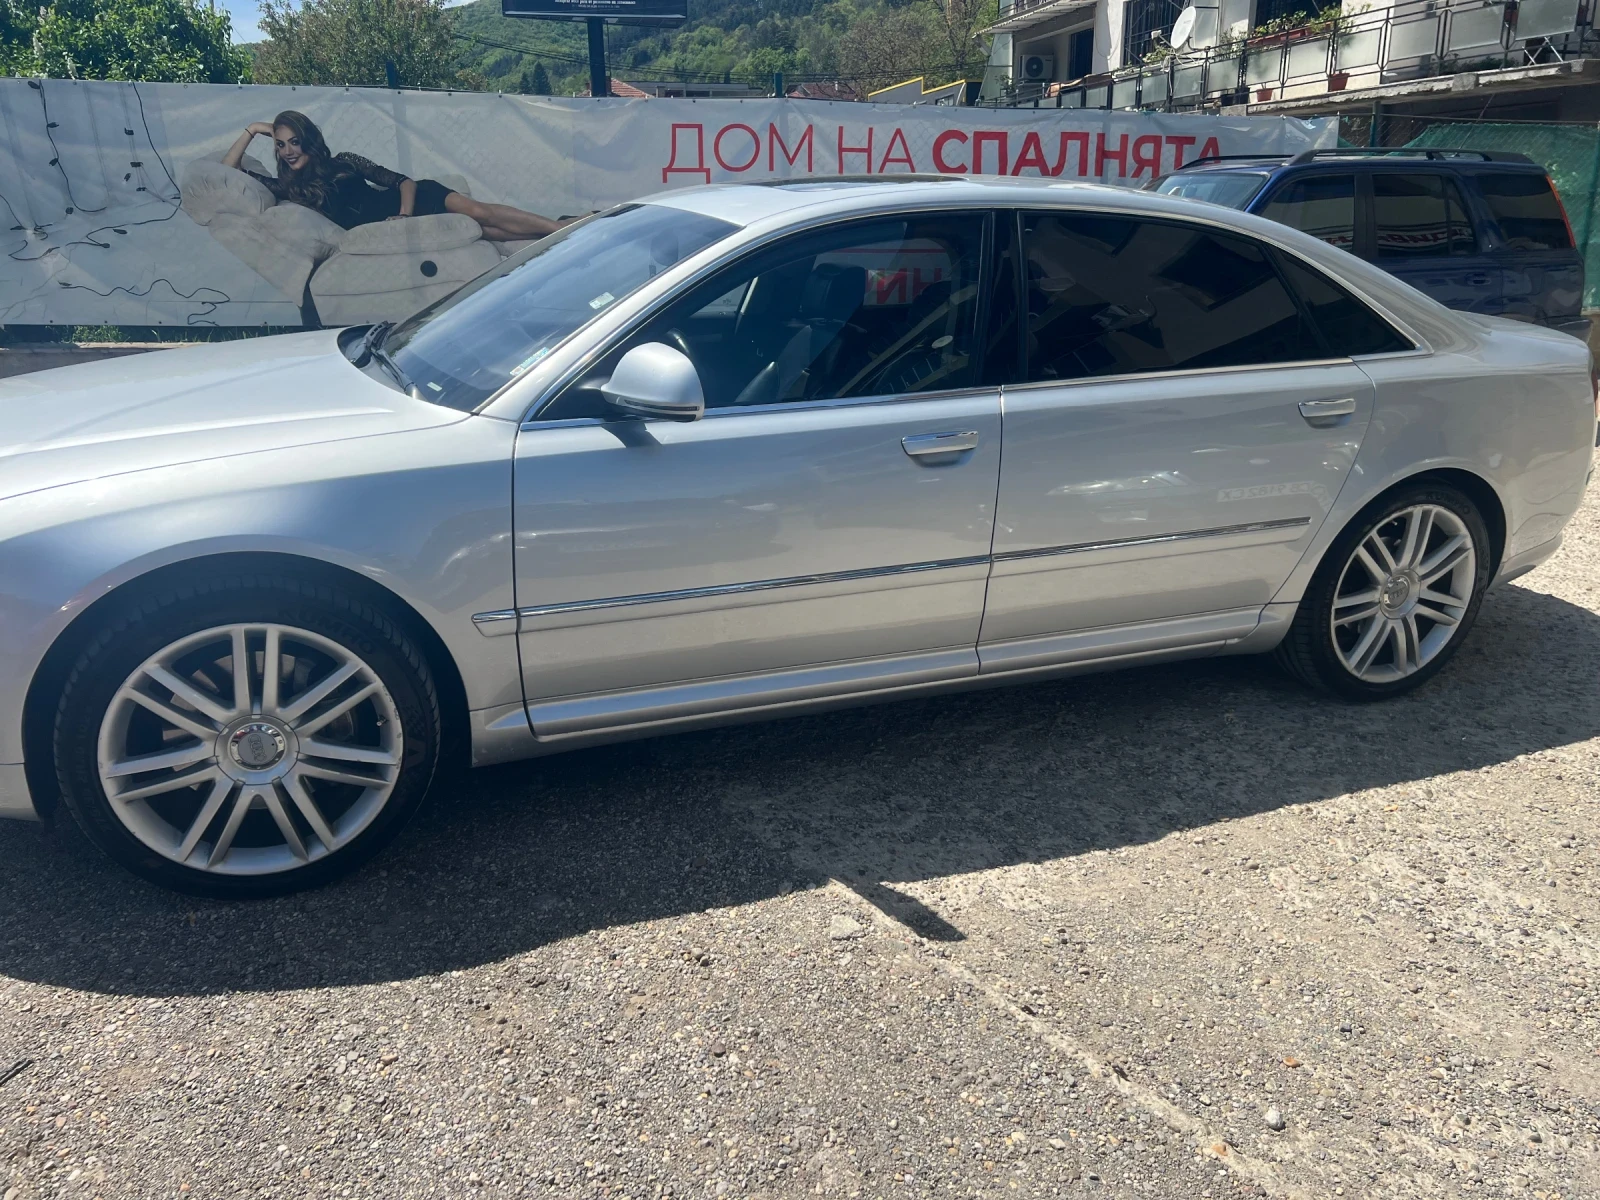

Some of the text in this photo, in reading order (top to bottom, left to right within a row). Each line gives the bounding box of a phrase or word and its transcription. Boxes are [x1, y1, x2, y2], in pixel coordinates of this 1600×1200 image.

[662, 123, 1221, 184] ДОМ НА СПАЛНЯТА
[277, 605, 376, 655] KUMHO
